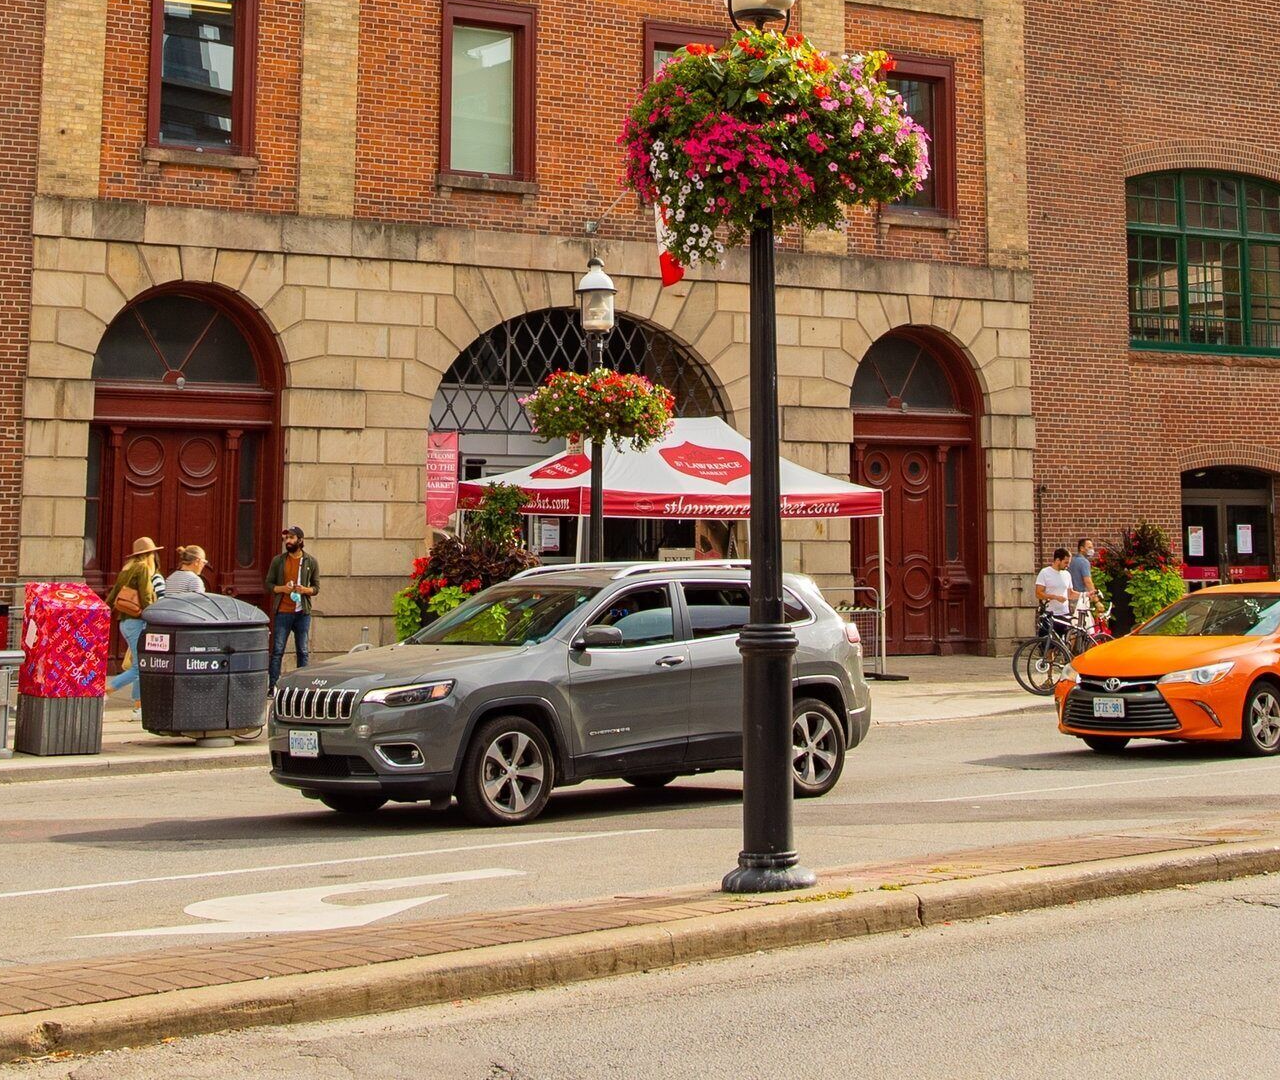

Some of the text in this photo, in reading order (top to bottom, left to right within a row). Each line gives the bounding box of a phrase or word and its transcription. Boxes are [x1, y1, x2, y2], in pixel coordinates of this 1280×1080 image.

[440, 464, 455, 472] THE
[553, 463, 578, 475] RENCE
[685, 460, 742, 471] LAWRENCE
[150, 657, 170, 669] Litter
[186, 659, 208, 670] Litter
[312, 678, 327, 686] Jeep
[589, 726, 631, 736] CHEROKEE
